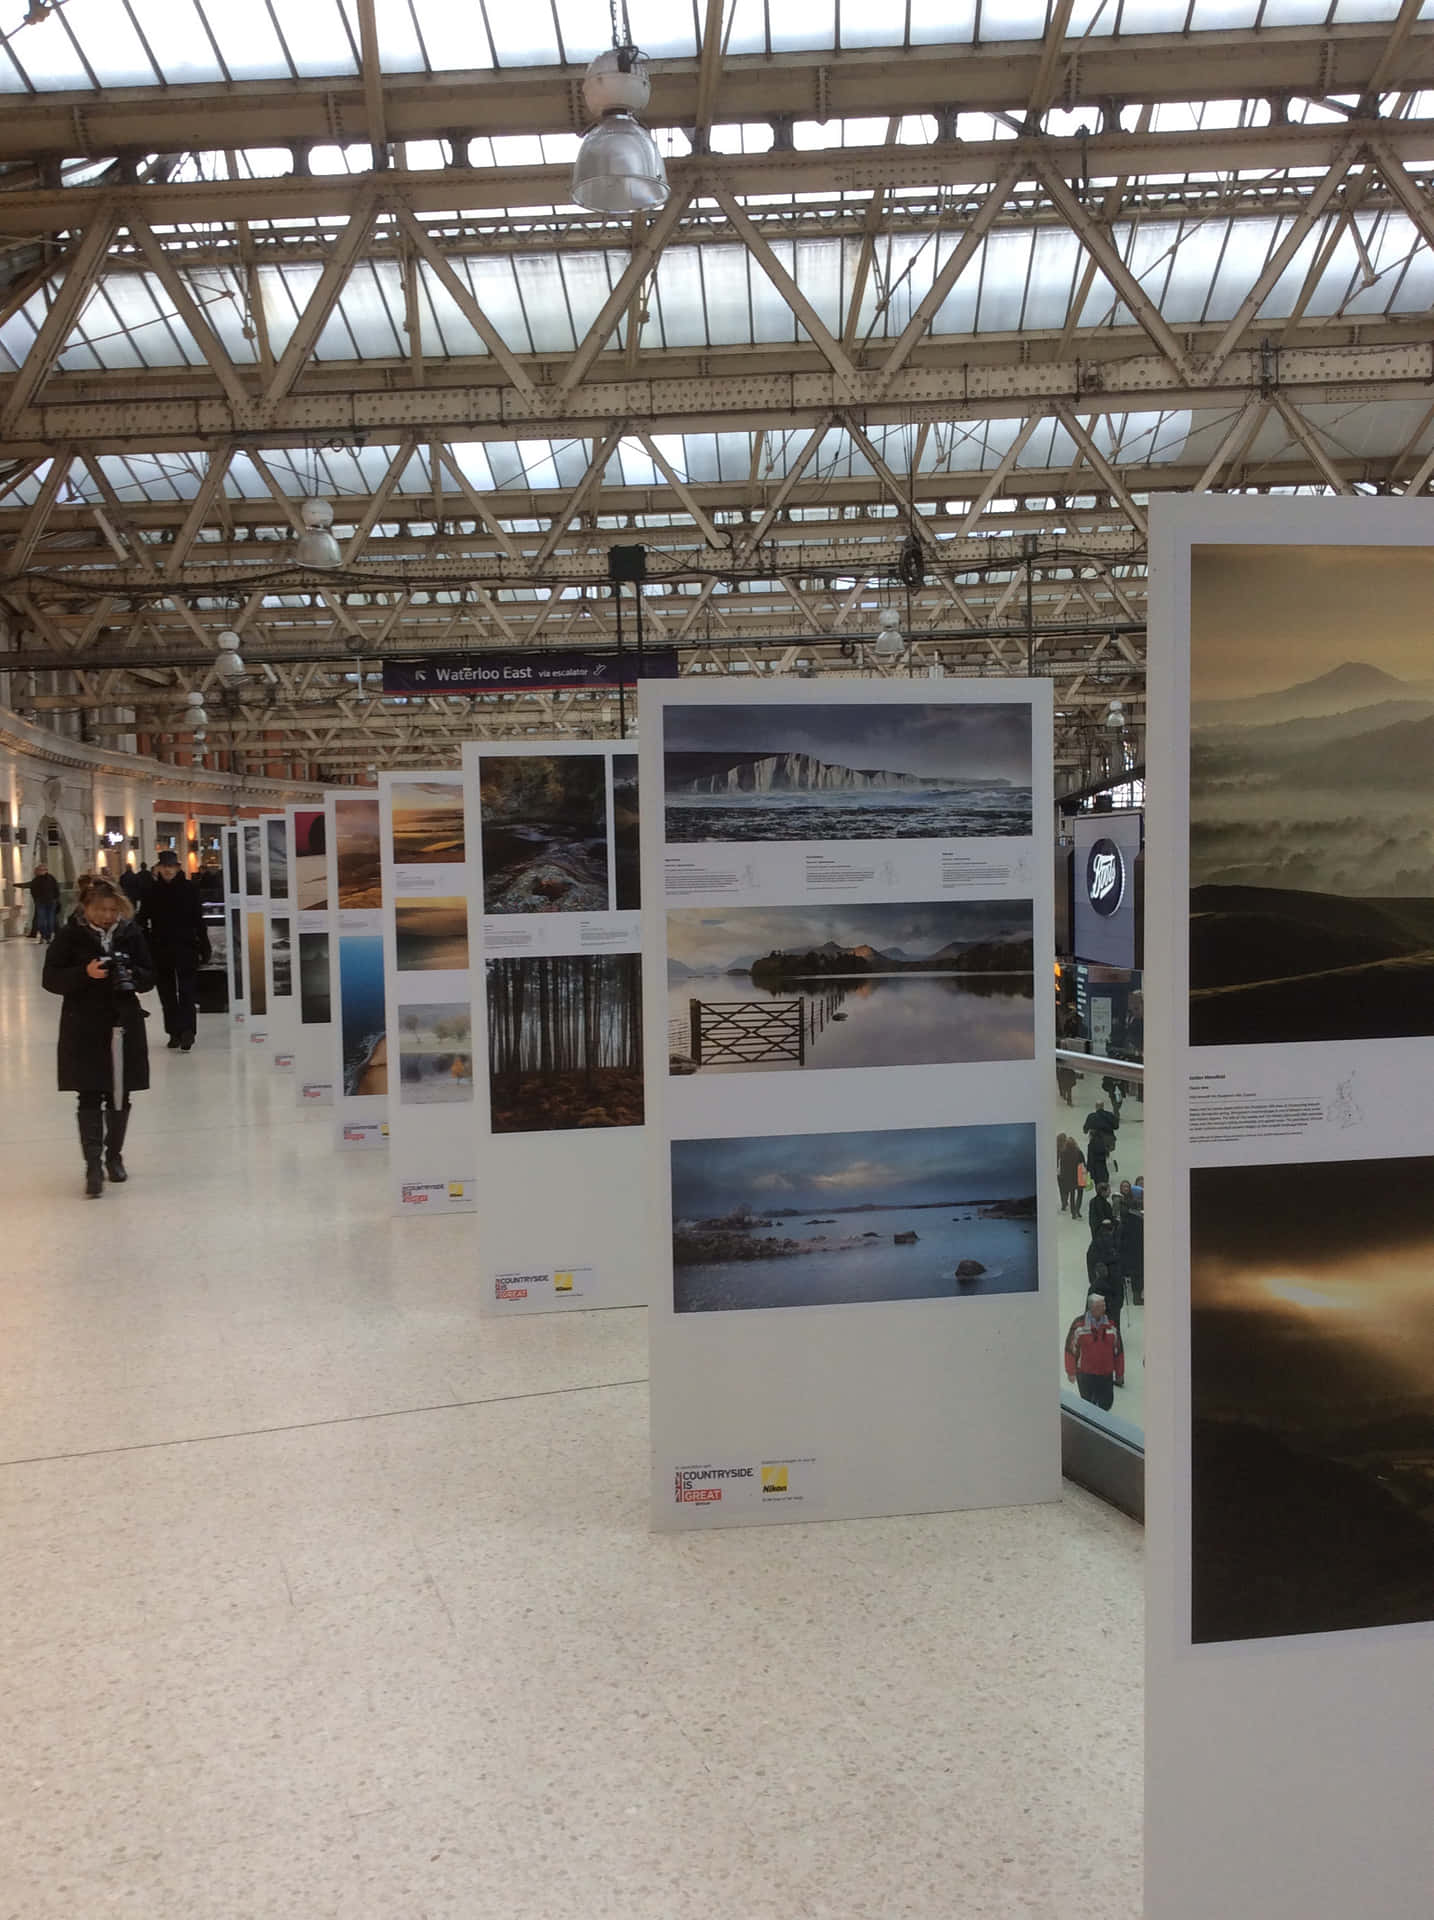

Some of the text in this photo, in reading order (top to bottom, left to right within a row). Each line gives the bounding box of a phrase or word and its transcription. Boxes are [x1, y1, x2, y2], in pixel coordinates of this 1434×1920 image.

[436, 667, 500, 681] Waterloo
[503, 667, 533, 679] East
[552, 669, 588, 677] escalator
[1091, 853, 1116, 900] Boots
[683, 1468, 753, 1480] COUNTRYSIDE
[683, 1481, 693, 1489] IS
[762, 1485, 788, 1494] Nikon
[685, 1490, 721, 1501] GREAT
